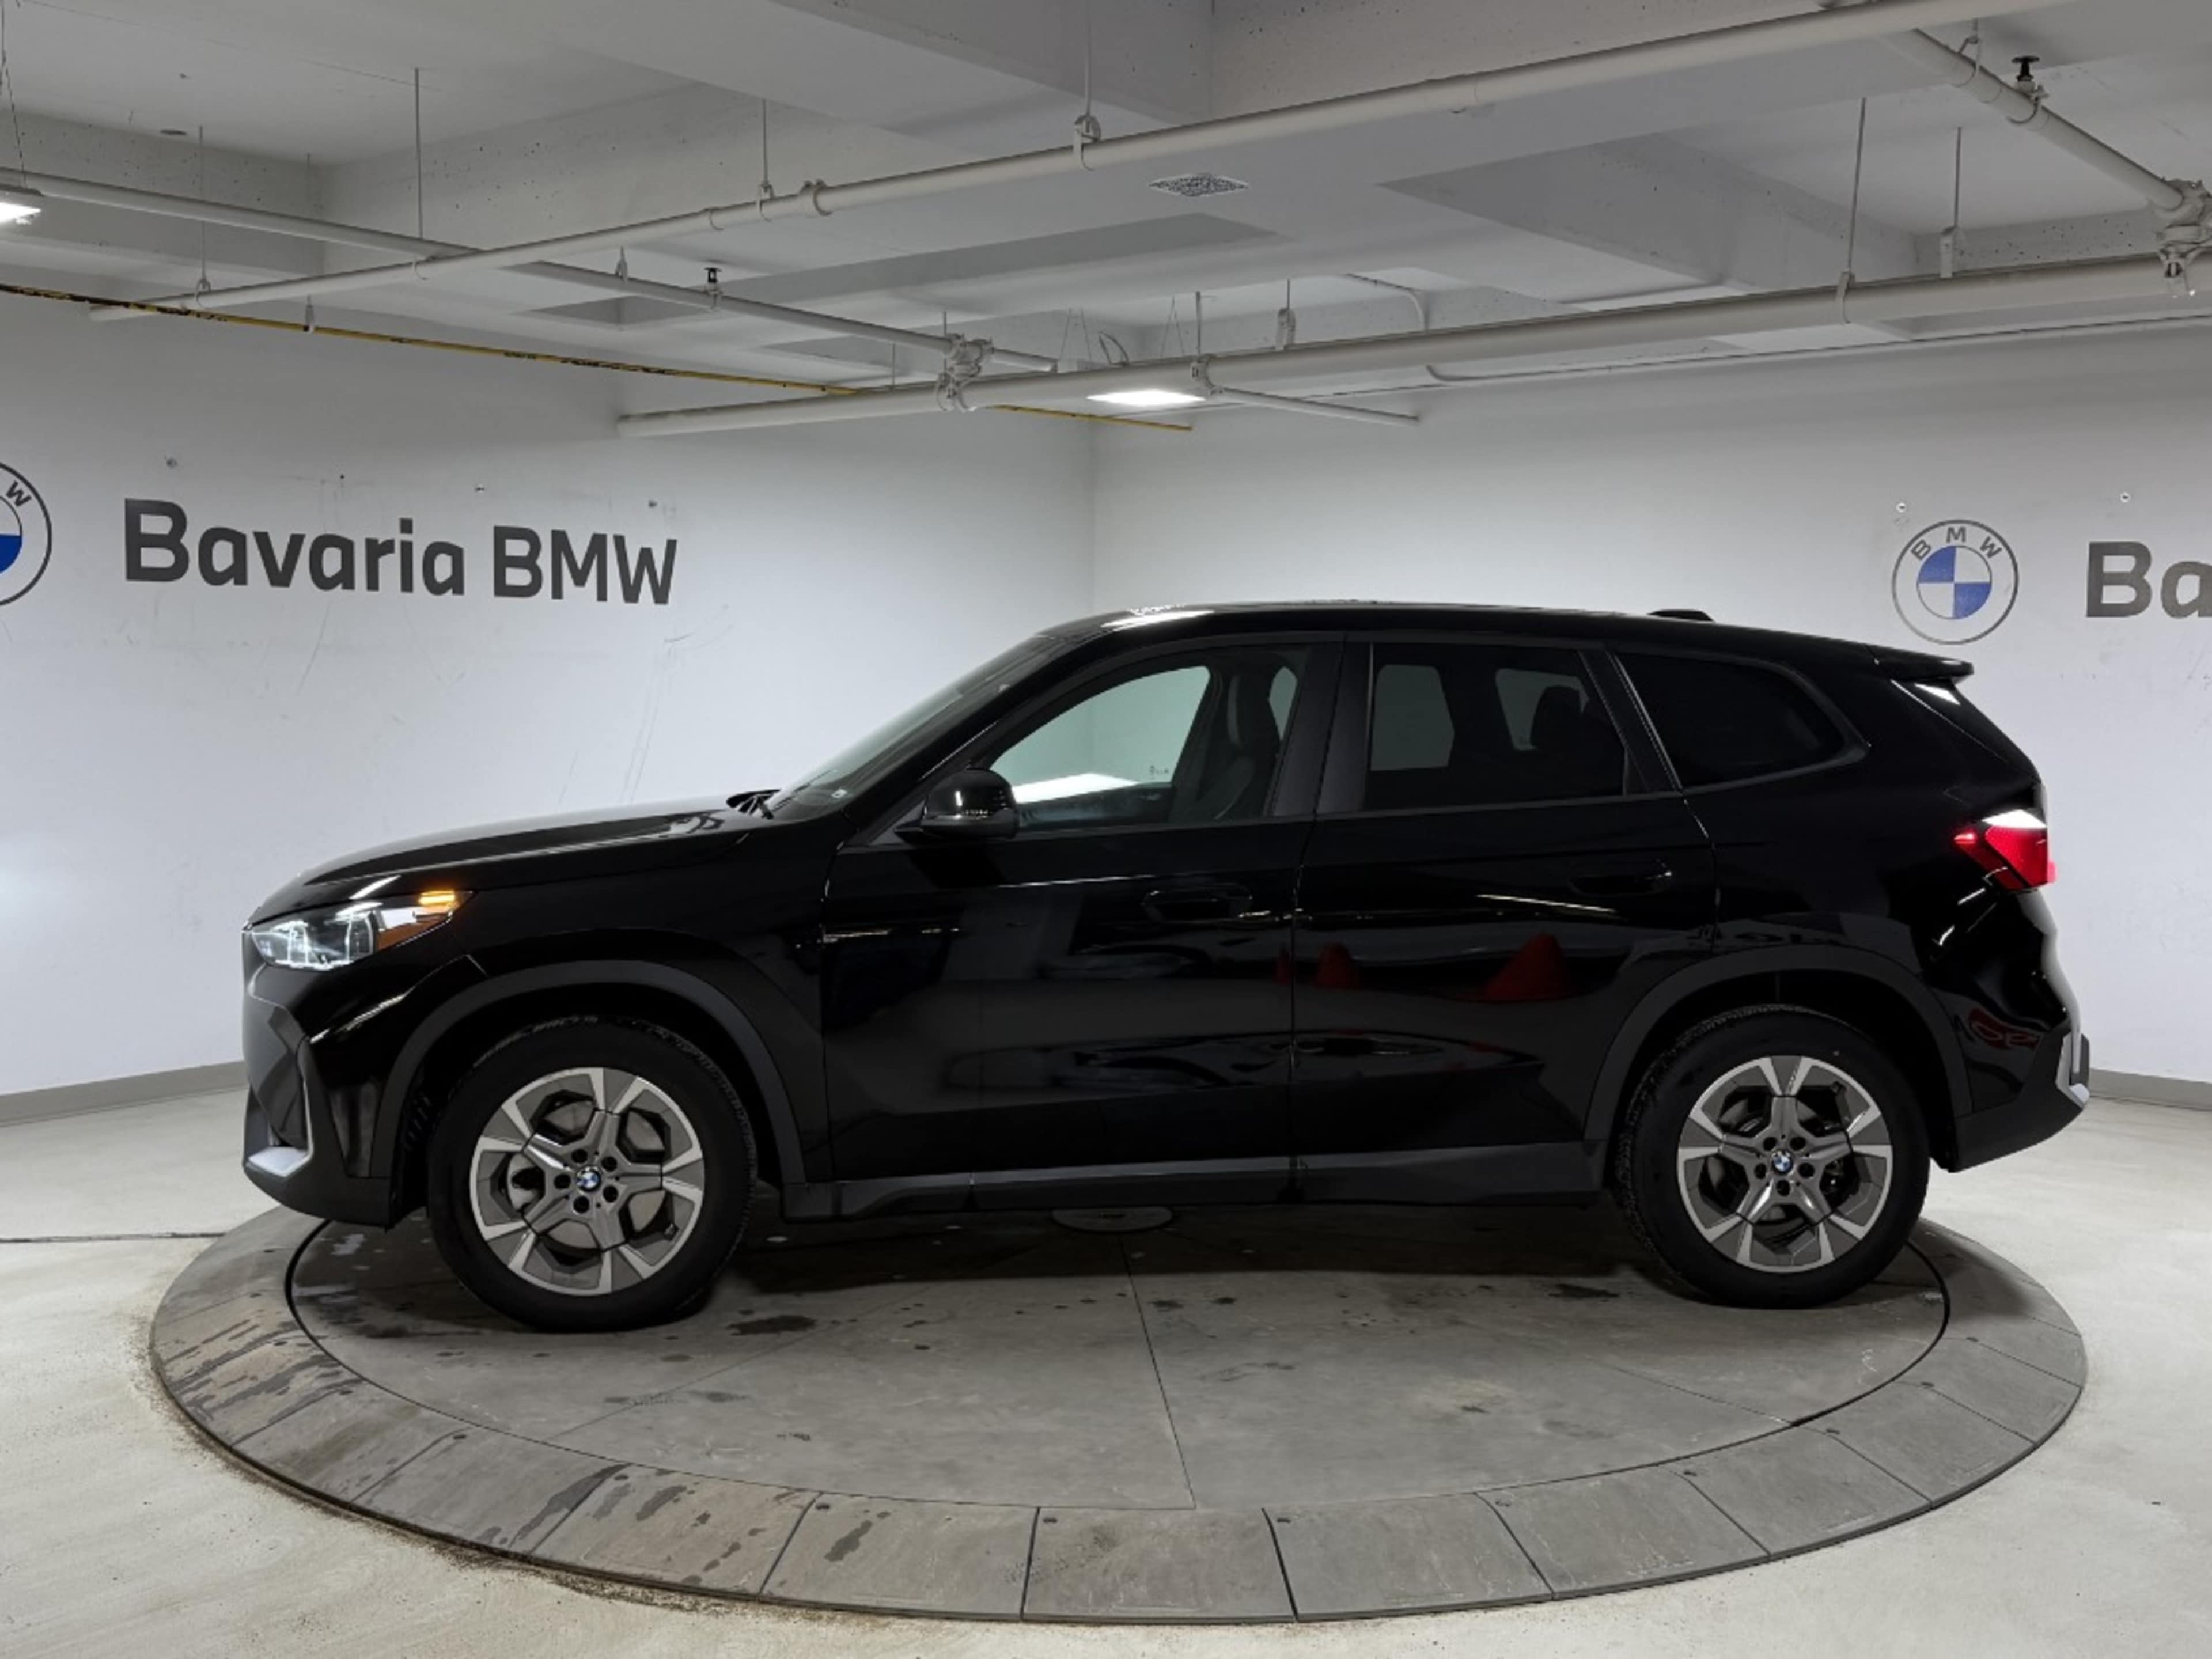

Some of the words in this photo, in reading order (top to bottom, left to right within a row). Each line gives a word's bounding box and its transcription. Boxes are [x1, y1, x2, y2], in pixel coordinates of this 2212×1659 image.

[124, 498, 464, 596] Bavaria
[493, 525, 677, 605] BMW
[1910, 527, 2002, 560] BMW
[2086, 541, 2212, 619] Ba
